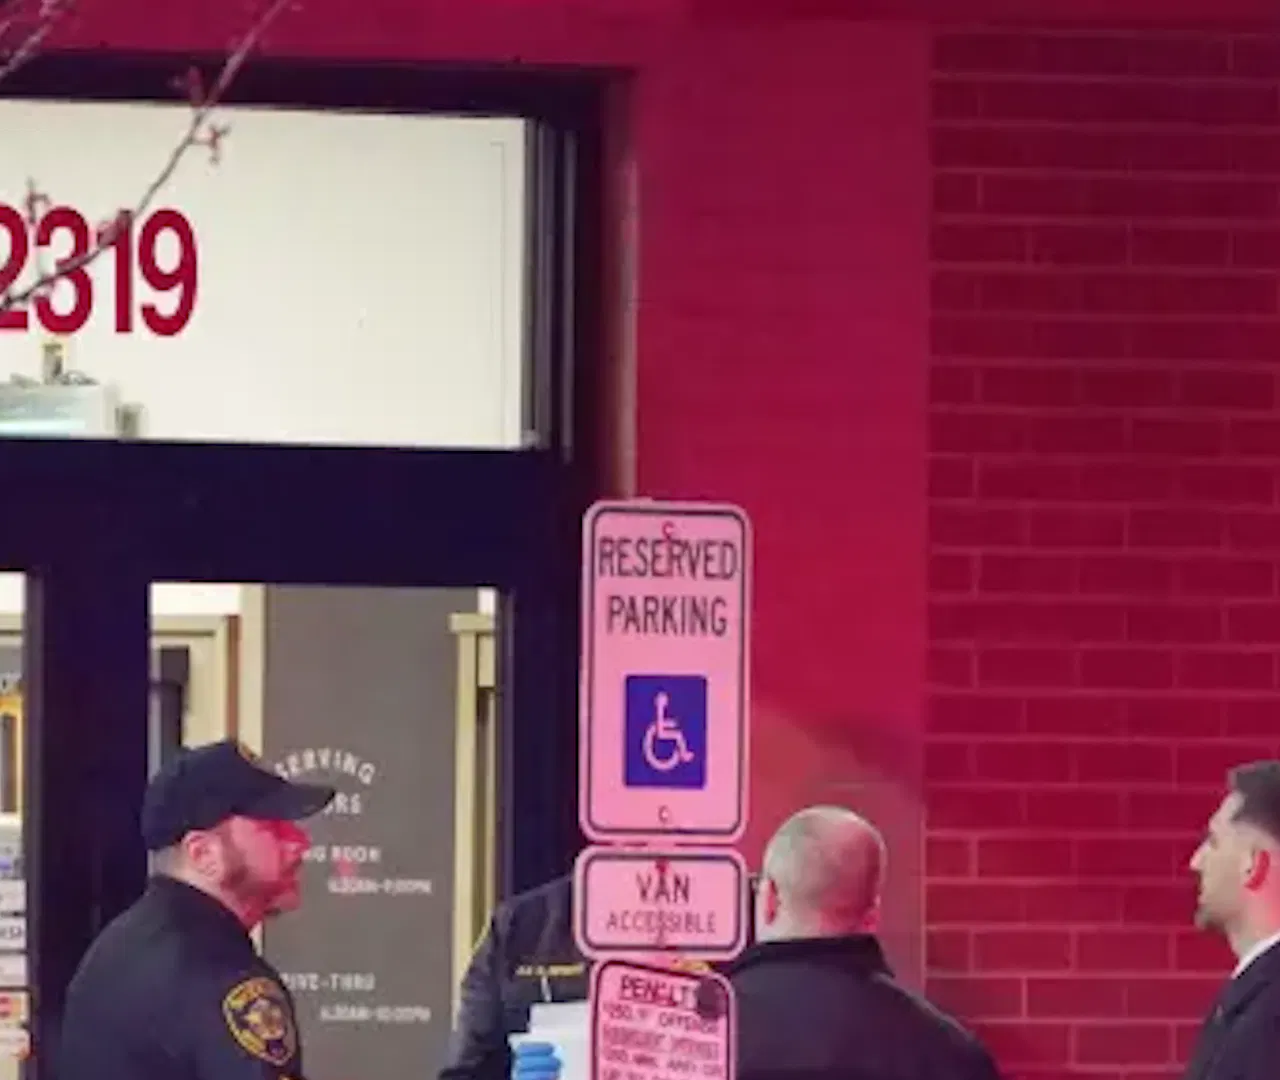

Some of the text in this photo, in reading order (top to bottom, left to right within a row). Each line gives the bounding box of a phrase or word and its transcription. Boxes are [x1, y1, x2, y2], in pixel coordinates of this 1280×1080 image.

[599, 536, 737, 580] RESERVED
[607, 595, 728, 637] PARKING
[274, 747, 376, 784] SERVING
[636, 872, 690, 903] VAN
[606, 910, 717, 935] ACCESSIBLE
